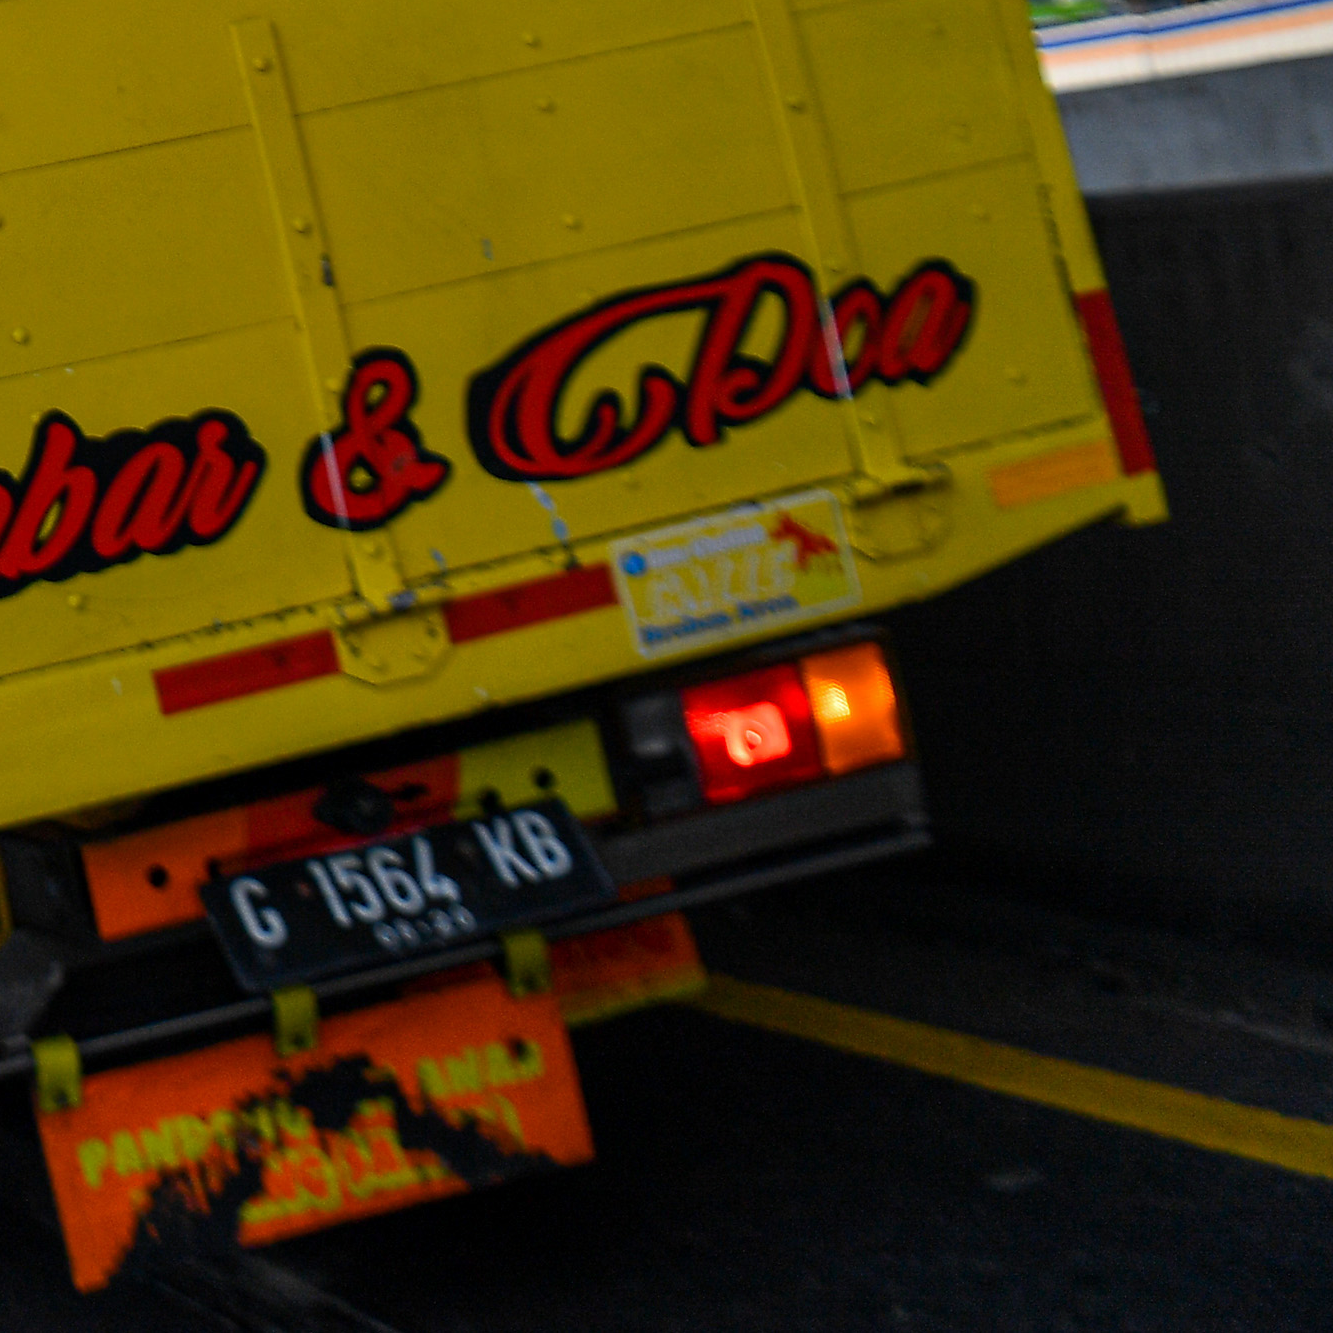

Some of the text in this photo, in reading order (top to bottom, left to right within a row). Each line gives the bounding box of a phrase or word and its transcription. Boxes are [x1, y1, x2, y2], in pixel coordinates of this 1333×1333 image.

[297, 347, 450, 529] &
[466, 251, 977, 484] Doa
[230, 875, 288, 950] G
[306, 835, 461, 928] 1564
[472, 808, 573, 889] KB
